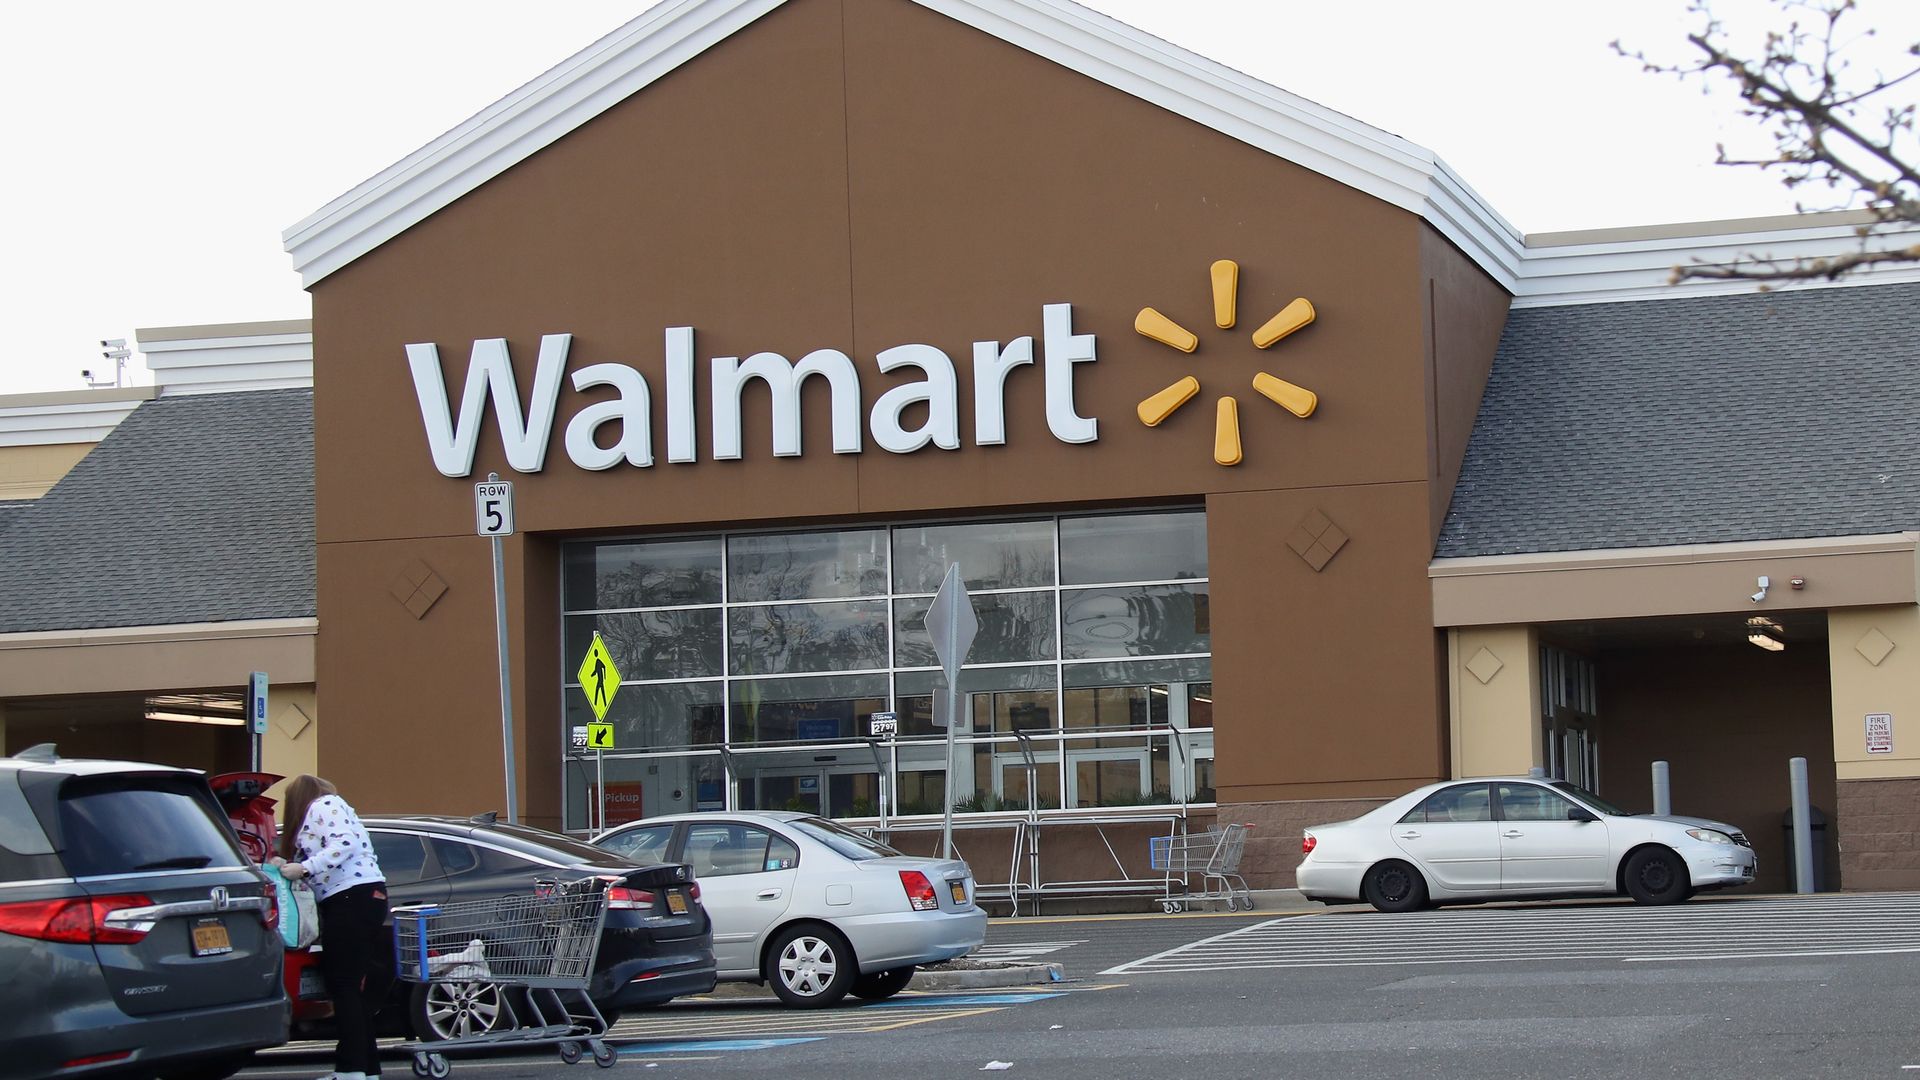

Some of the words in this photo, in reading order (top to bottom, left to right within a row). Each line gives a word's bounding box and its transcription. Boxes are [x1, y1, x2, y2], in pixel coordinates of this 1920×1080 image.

[405, 303, 1098, 478] Walmart
[479, 486, 506, 496] ROW
[486, 501, 503, 531] 5
[605, 793, 639, 804] Pickup
